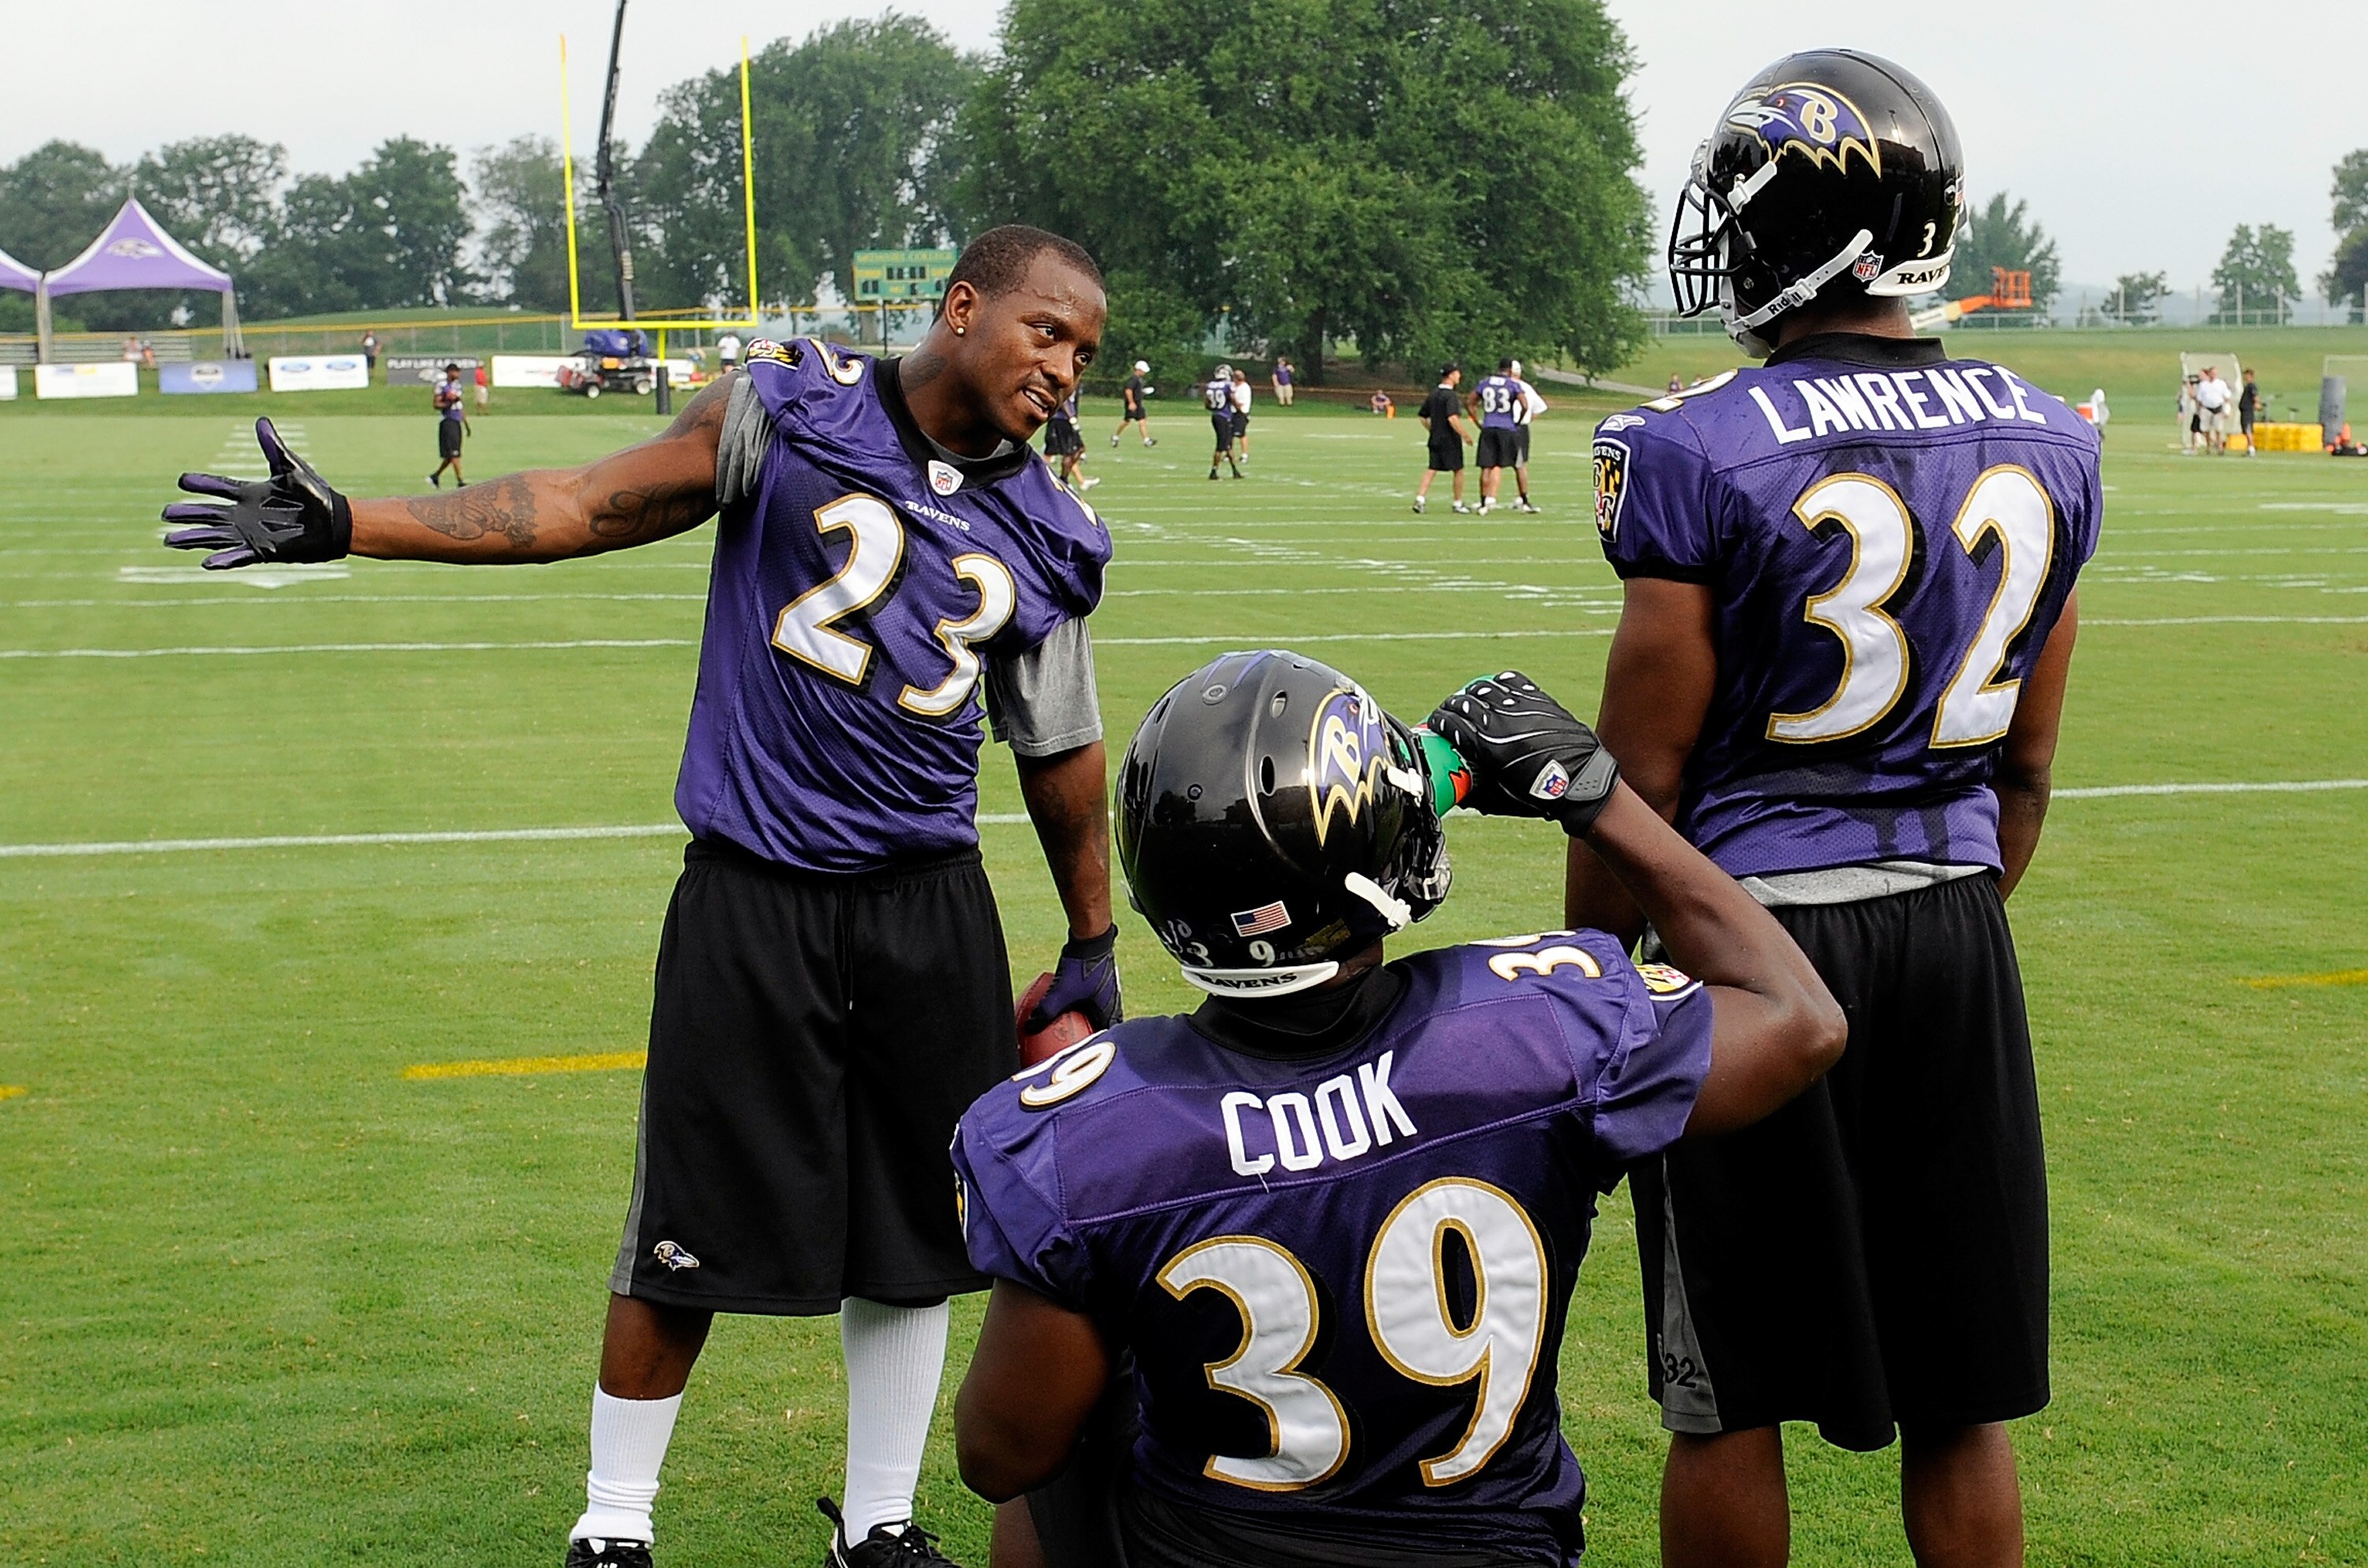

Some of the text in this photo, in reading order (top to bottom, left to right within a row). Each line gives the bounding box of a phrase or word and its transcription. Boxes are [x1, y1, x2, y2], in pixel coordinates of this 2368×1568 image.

[1857, 263, 1877, 279] NFL
[1767, 291, 1804, 316] Ridll
[1482, 387, 1512, 414] 83
[1748, 365, 2048, 445] LAWRENCE
[905, 500, 971, 531] RAVENS
[771, 492, 1016, 717] 23
[1765, 462, 2055, 750] 32
[1220, 1050, 1418, 1176] COOK
[1156, 1176, 1549, 1493] 39
[1664, 1353, 1697, 1389] 32
